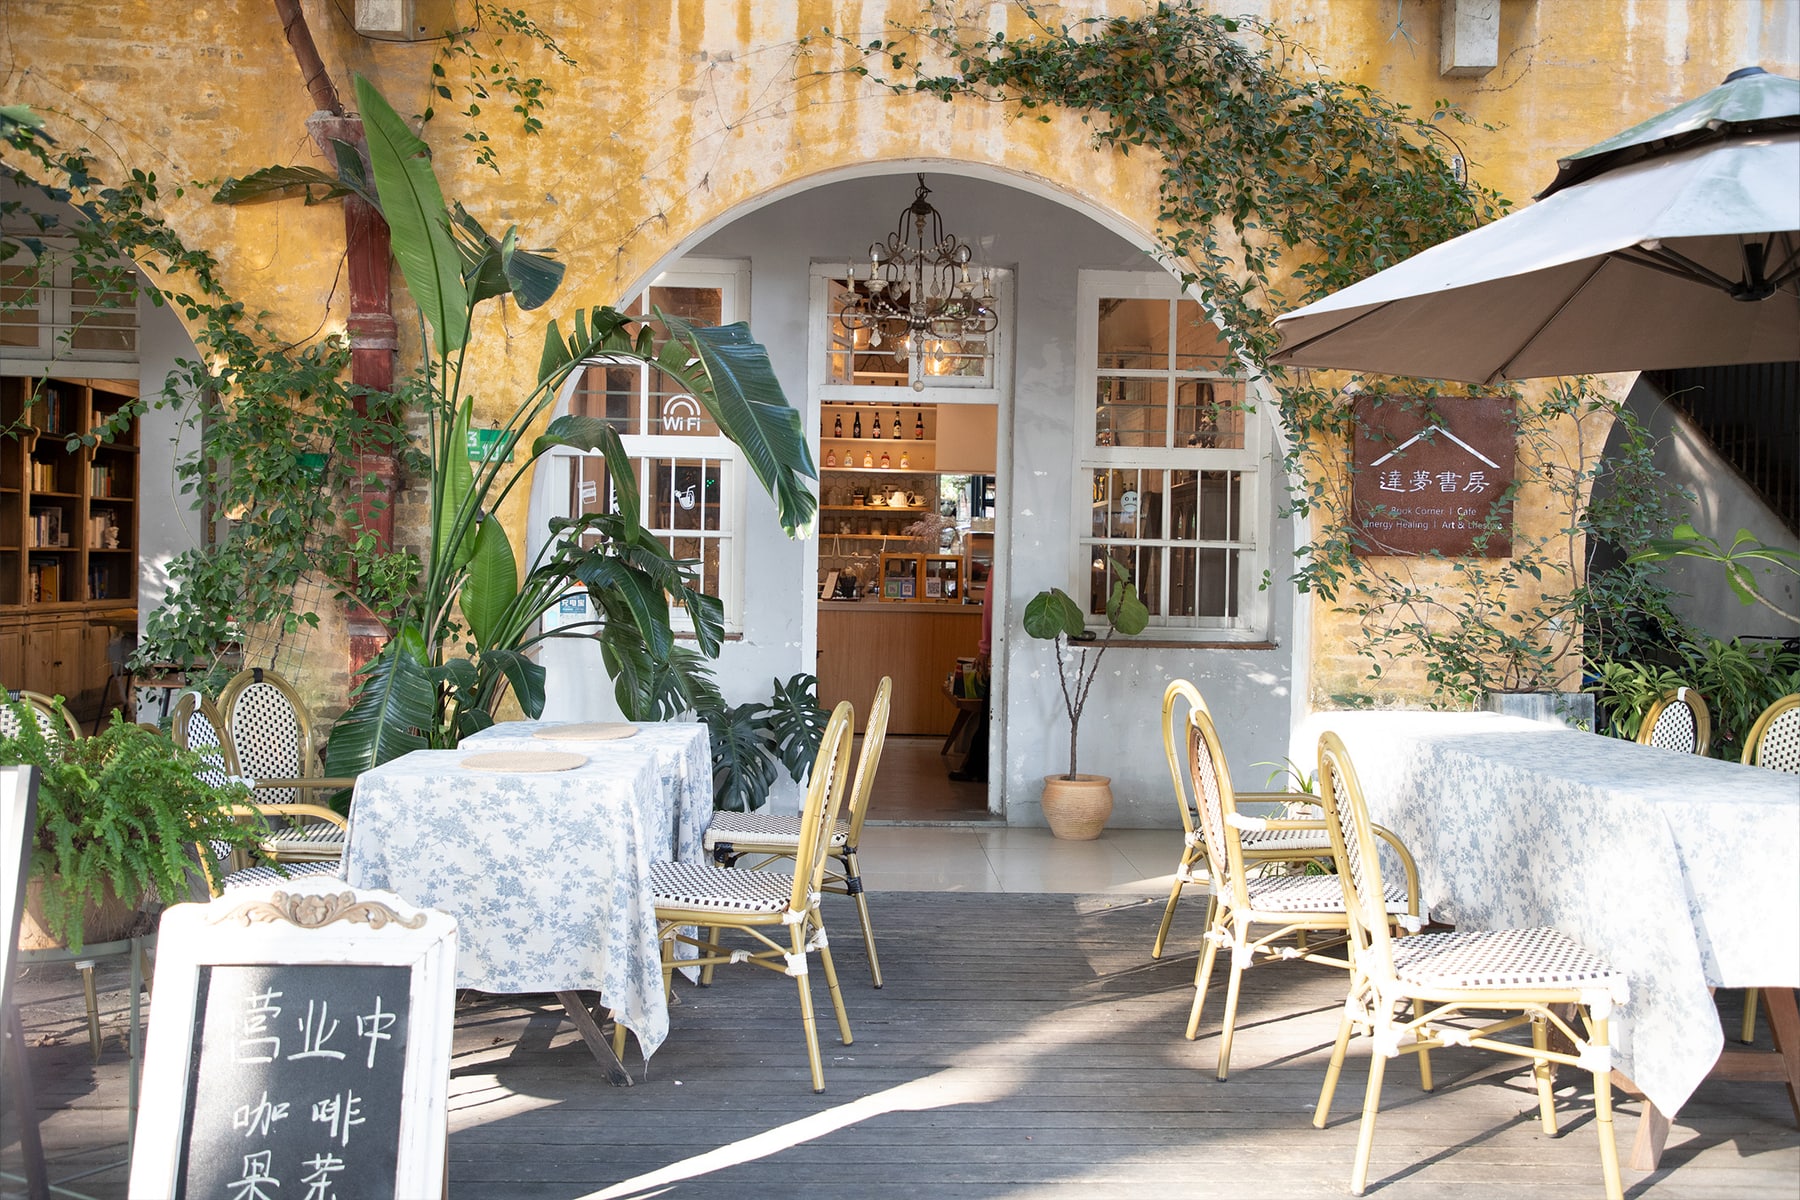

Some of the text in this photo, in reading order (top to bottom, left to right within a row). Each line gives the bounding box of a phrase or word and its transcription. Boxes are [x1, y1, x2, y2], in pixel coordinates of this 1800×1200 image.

[1379, 470, 1490, 494] 達夢書房
[1414, 506, 1444, 516] Corner
[1456, 506, 1477, 516] Cafe
[1363, 521, 1393, 531] nergy
[1396, 520, 1429, 531] Healing
[1441, 521, 1455, 530] Art
[1457, 521, 1465, 530] &
[231, 986, 396, 1069] 营业中
[233, 1089, 366, 1147] 咖啡
